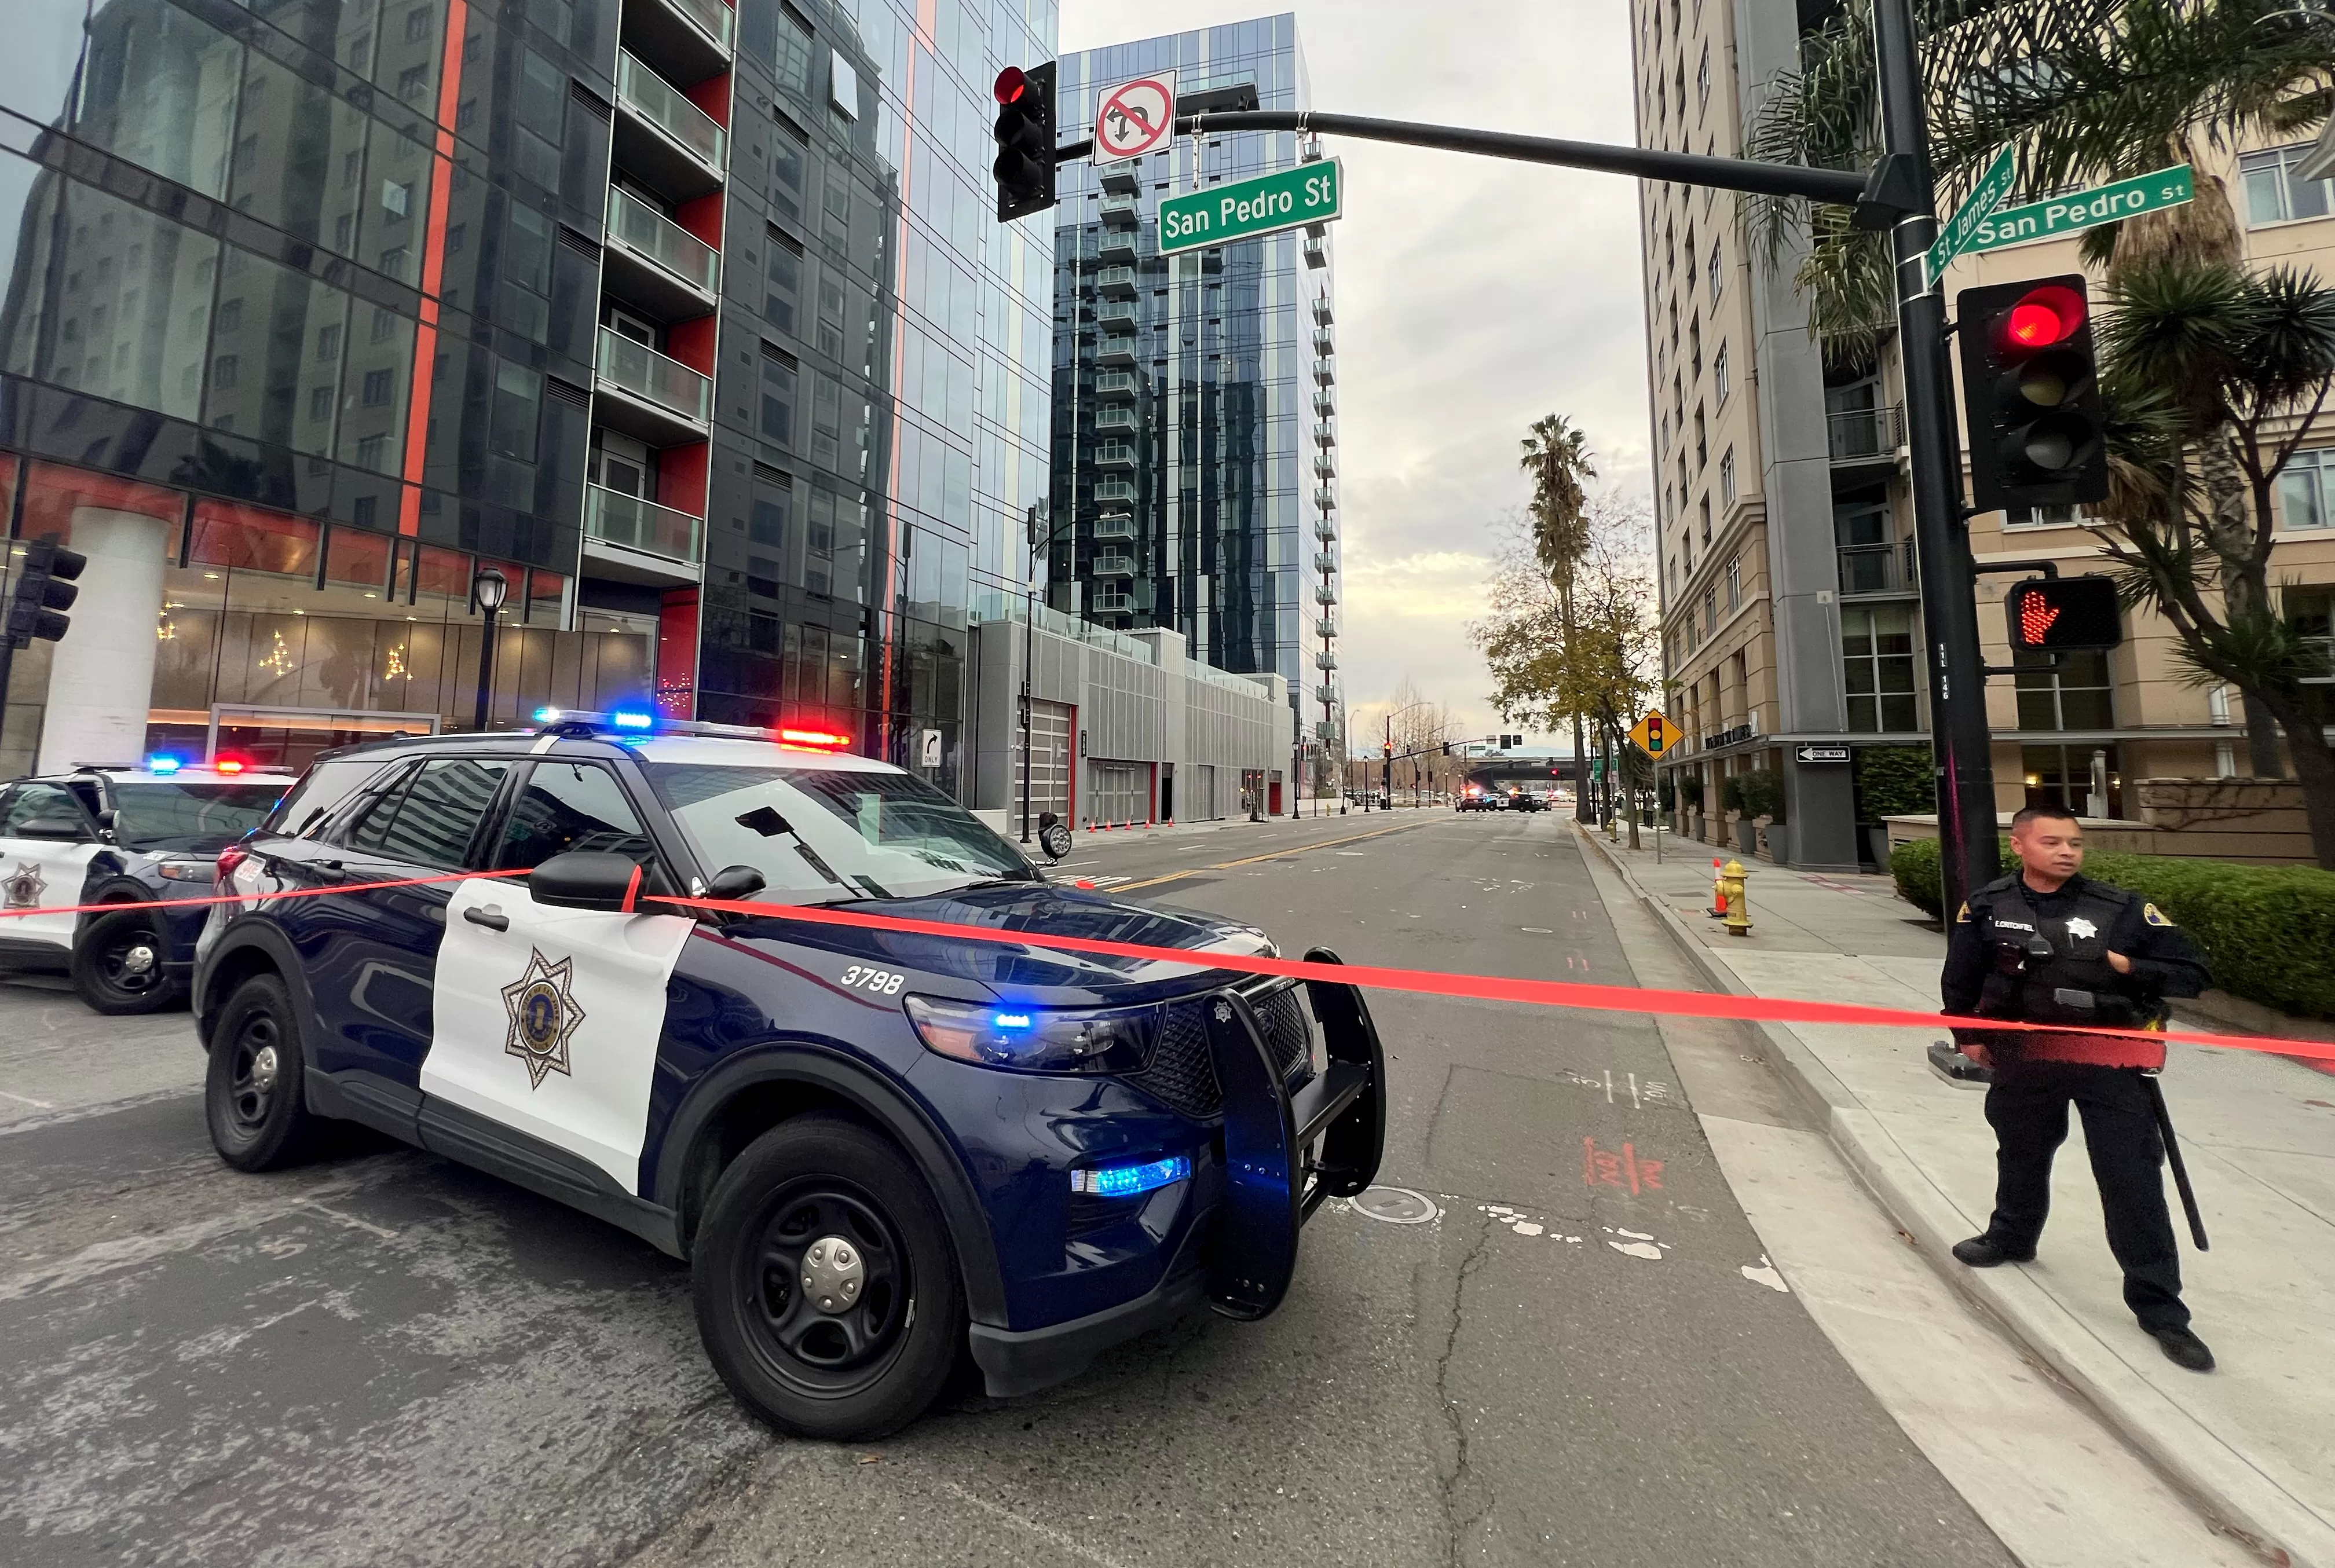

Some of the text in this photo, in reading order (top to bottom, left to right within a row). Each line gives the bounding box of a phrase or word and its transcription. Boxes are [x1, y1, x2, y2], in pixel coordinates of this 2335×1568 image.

[1166, 175, 1332, 238] San Pedro St
[1938, 236, 1951, 266] St
[1955, 180, 1995, 246] James
[2001, 167, 2012, 186] St
[1978, 183, 2185, 243] San Pedro St
[840, 965, 905, 995] 3798
